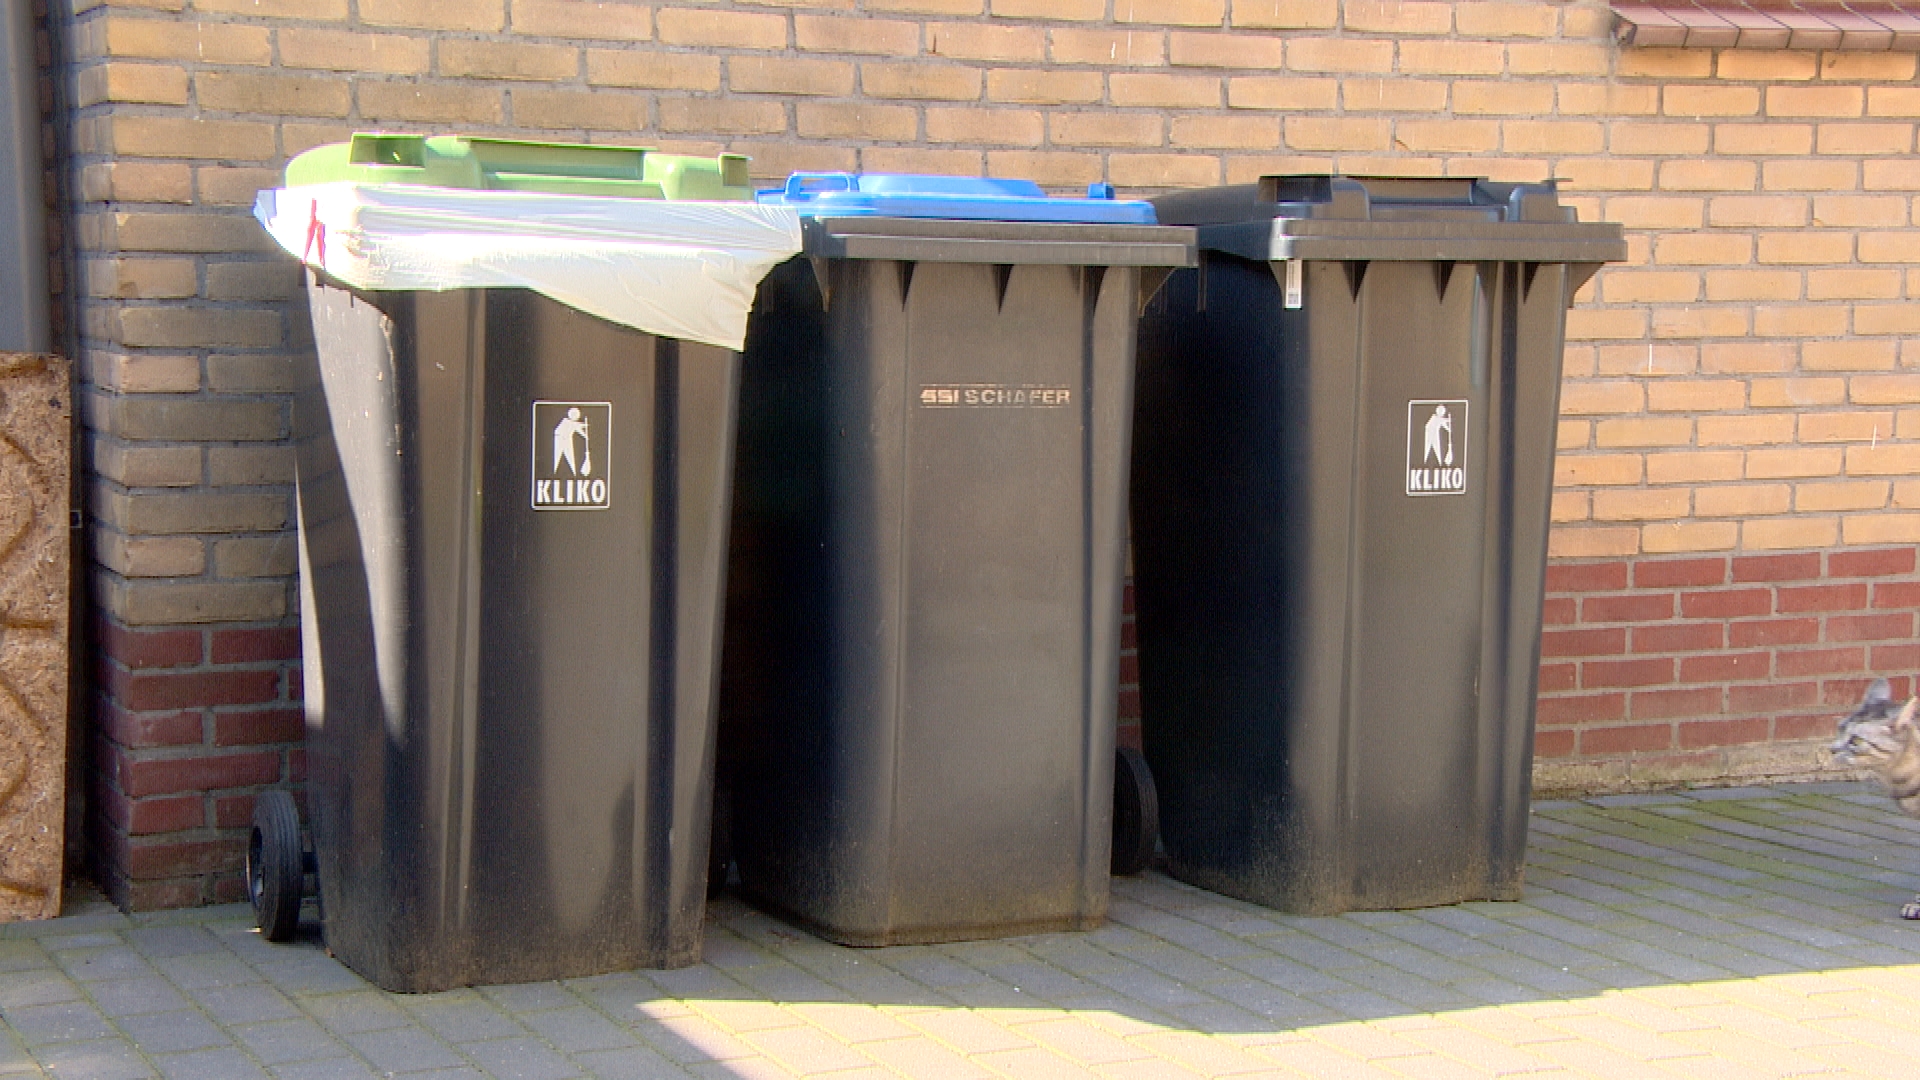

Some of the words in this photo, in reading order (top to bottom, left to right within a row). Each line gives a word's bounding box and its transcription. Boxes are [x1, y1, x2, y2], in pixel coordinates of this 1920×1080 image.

[920, 389, 959, 403] SSI
[1410, 467, 1463, 490] KLIKO
[536, 479, 606, 504] KLIKO
